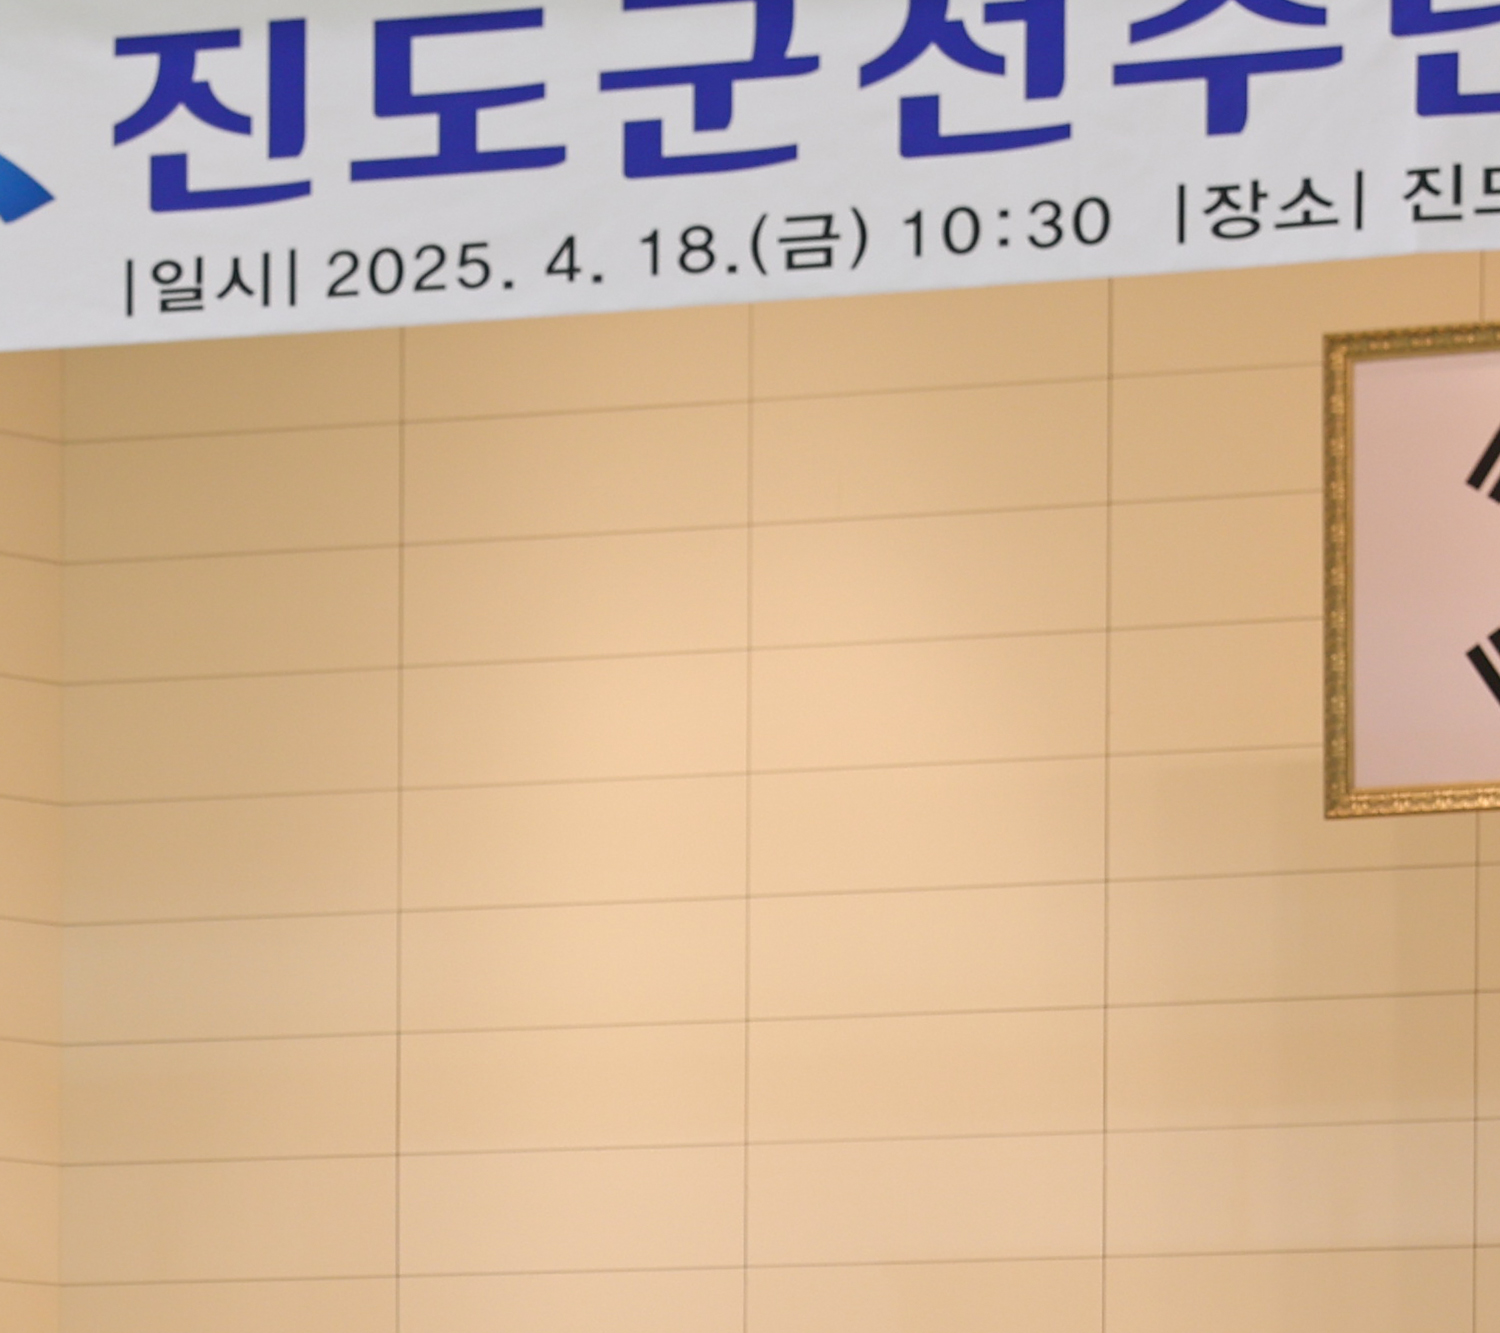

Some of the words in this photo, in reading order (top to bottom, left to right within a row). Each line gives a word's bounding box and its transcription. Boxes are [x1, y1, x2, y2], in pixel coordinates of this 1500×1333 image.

[326, 241, 515, 298] 2025.
[545, 236, 604, 284] 4.
[902, 196, 1112, 257] 10:30
